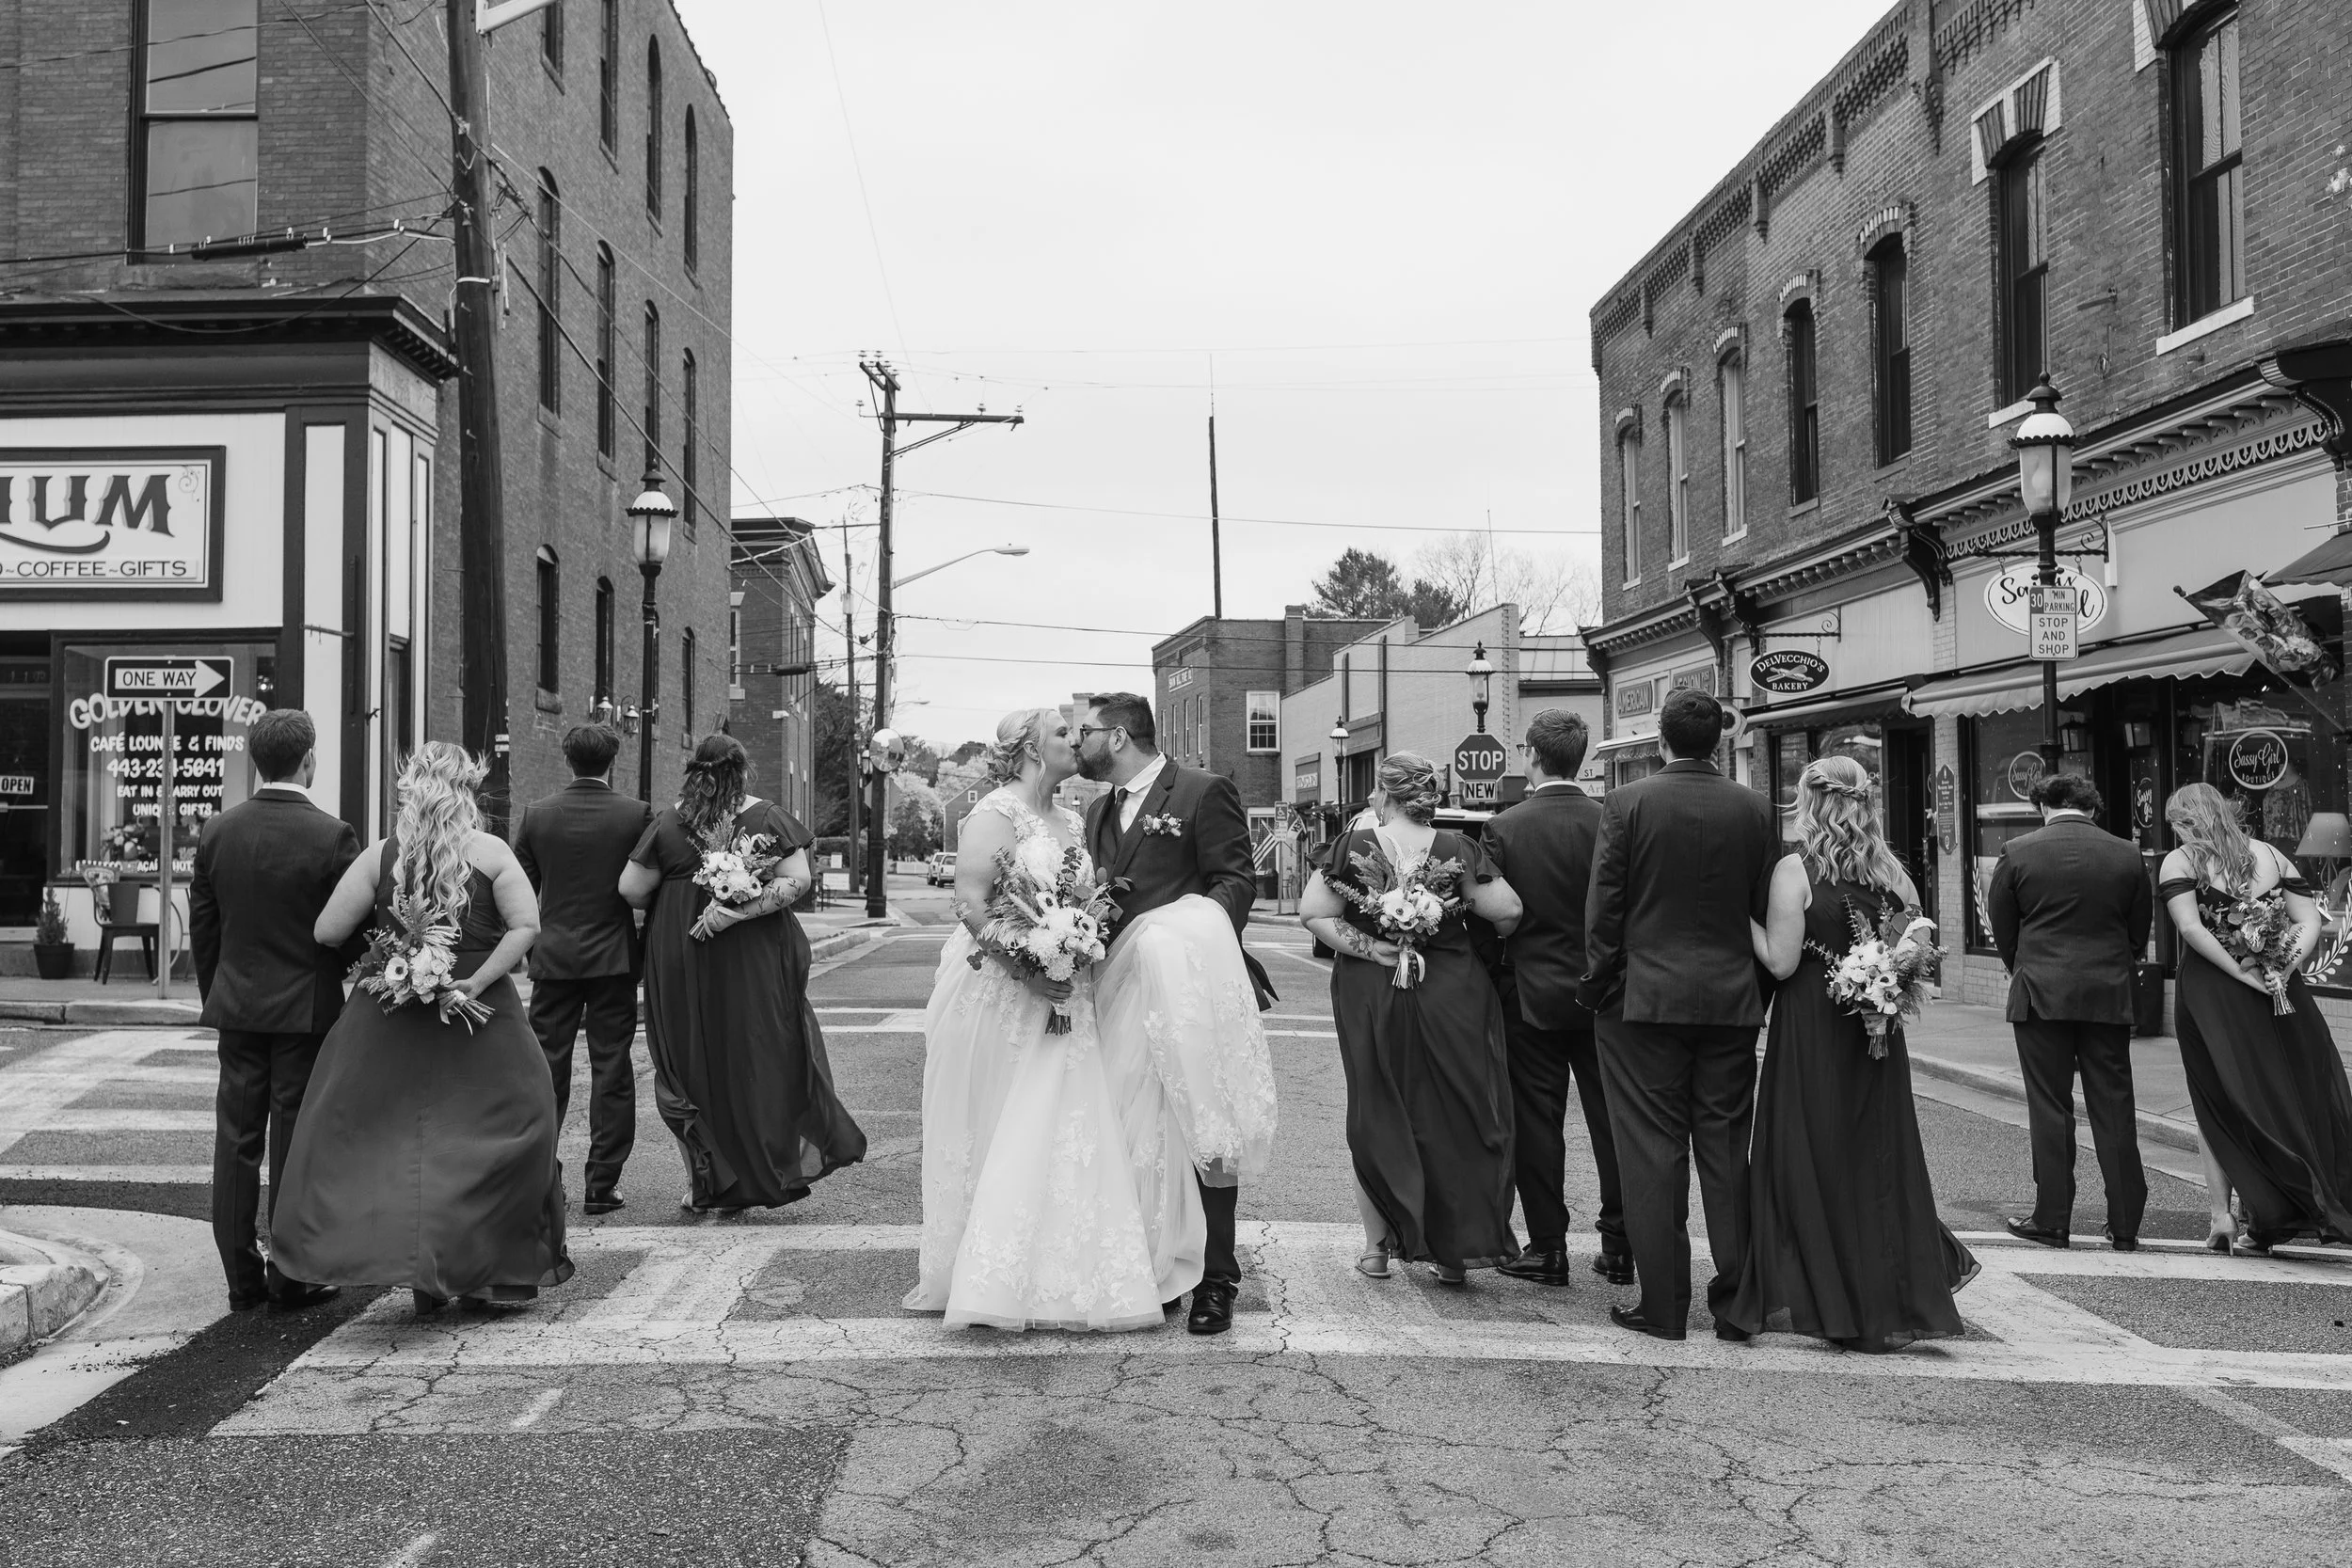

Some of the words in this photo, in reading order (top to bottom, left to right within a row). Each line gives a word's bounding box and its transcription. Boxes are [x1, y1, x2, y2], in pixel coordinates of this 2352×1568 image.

[2031, 594, 2043, 608] 30
[2052, 590, 2065, 599] MIN
[2044, 602, 2074, 612] PARKING
[2039, 617, 2068, 627] STOP
[2042, 631, 2065, 641] AND
[2038, 643, 2069, 655] SHOP
[122, 671, 156, 687] ONE
[162, 671, 197, 687] WAY
[1772, 682, 1808, 690] BAKERY
[129, 735, 182, 752] LOUNE
[188, 735, 199, 752] &
[204, 735, 245, 752] FINDS
[1457, 750, 1504, 771] STOP
[1583, 768, 1594, 778] ST
[1, 778, 32, 793] OPEN
[117, 784, 137, 799] EAT
[140, 784, 154, 799] IN
[172, 784, 200, 798] ARRY
[201, 784, 225, 798] OUT
[1466, 783, 1496, 799] NEW
[133, 802, 163, 818] UNIQ
[179, 802, 213, 816] GIFTS
